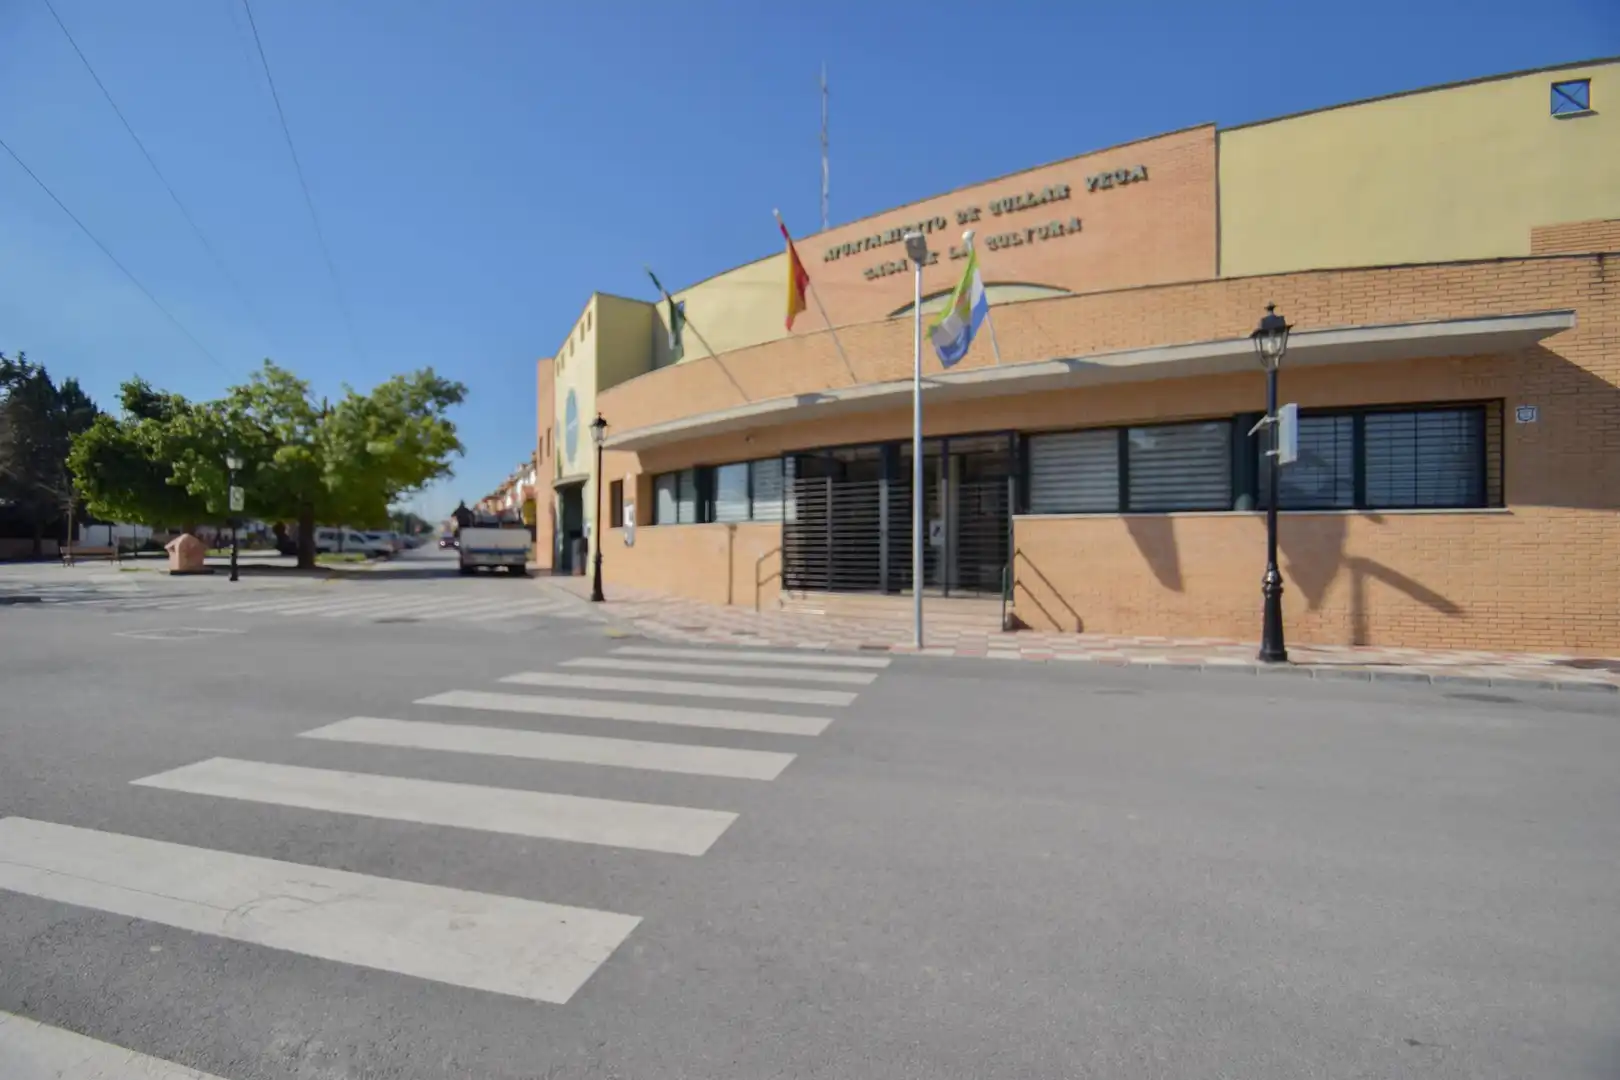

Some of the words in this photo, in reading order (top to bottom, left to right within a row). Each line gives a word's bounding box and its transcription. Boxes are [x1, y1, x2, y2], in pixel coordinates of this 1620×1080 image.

[956, 207, 982, 225] DE
[1085, 165, 1149, 192] VEGA
[863, 258, 908, 281] CASA
[985, 216, 1082, 251] CULTURA
